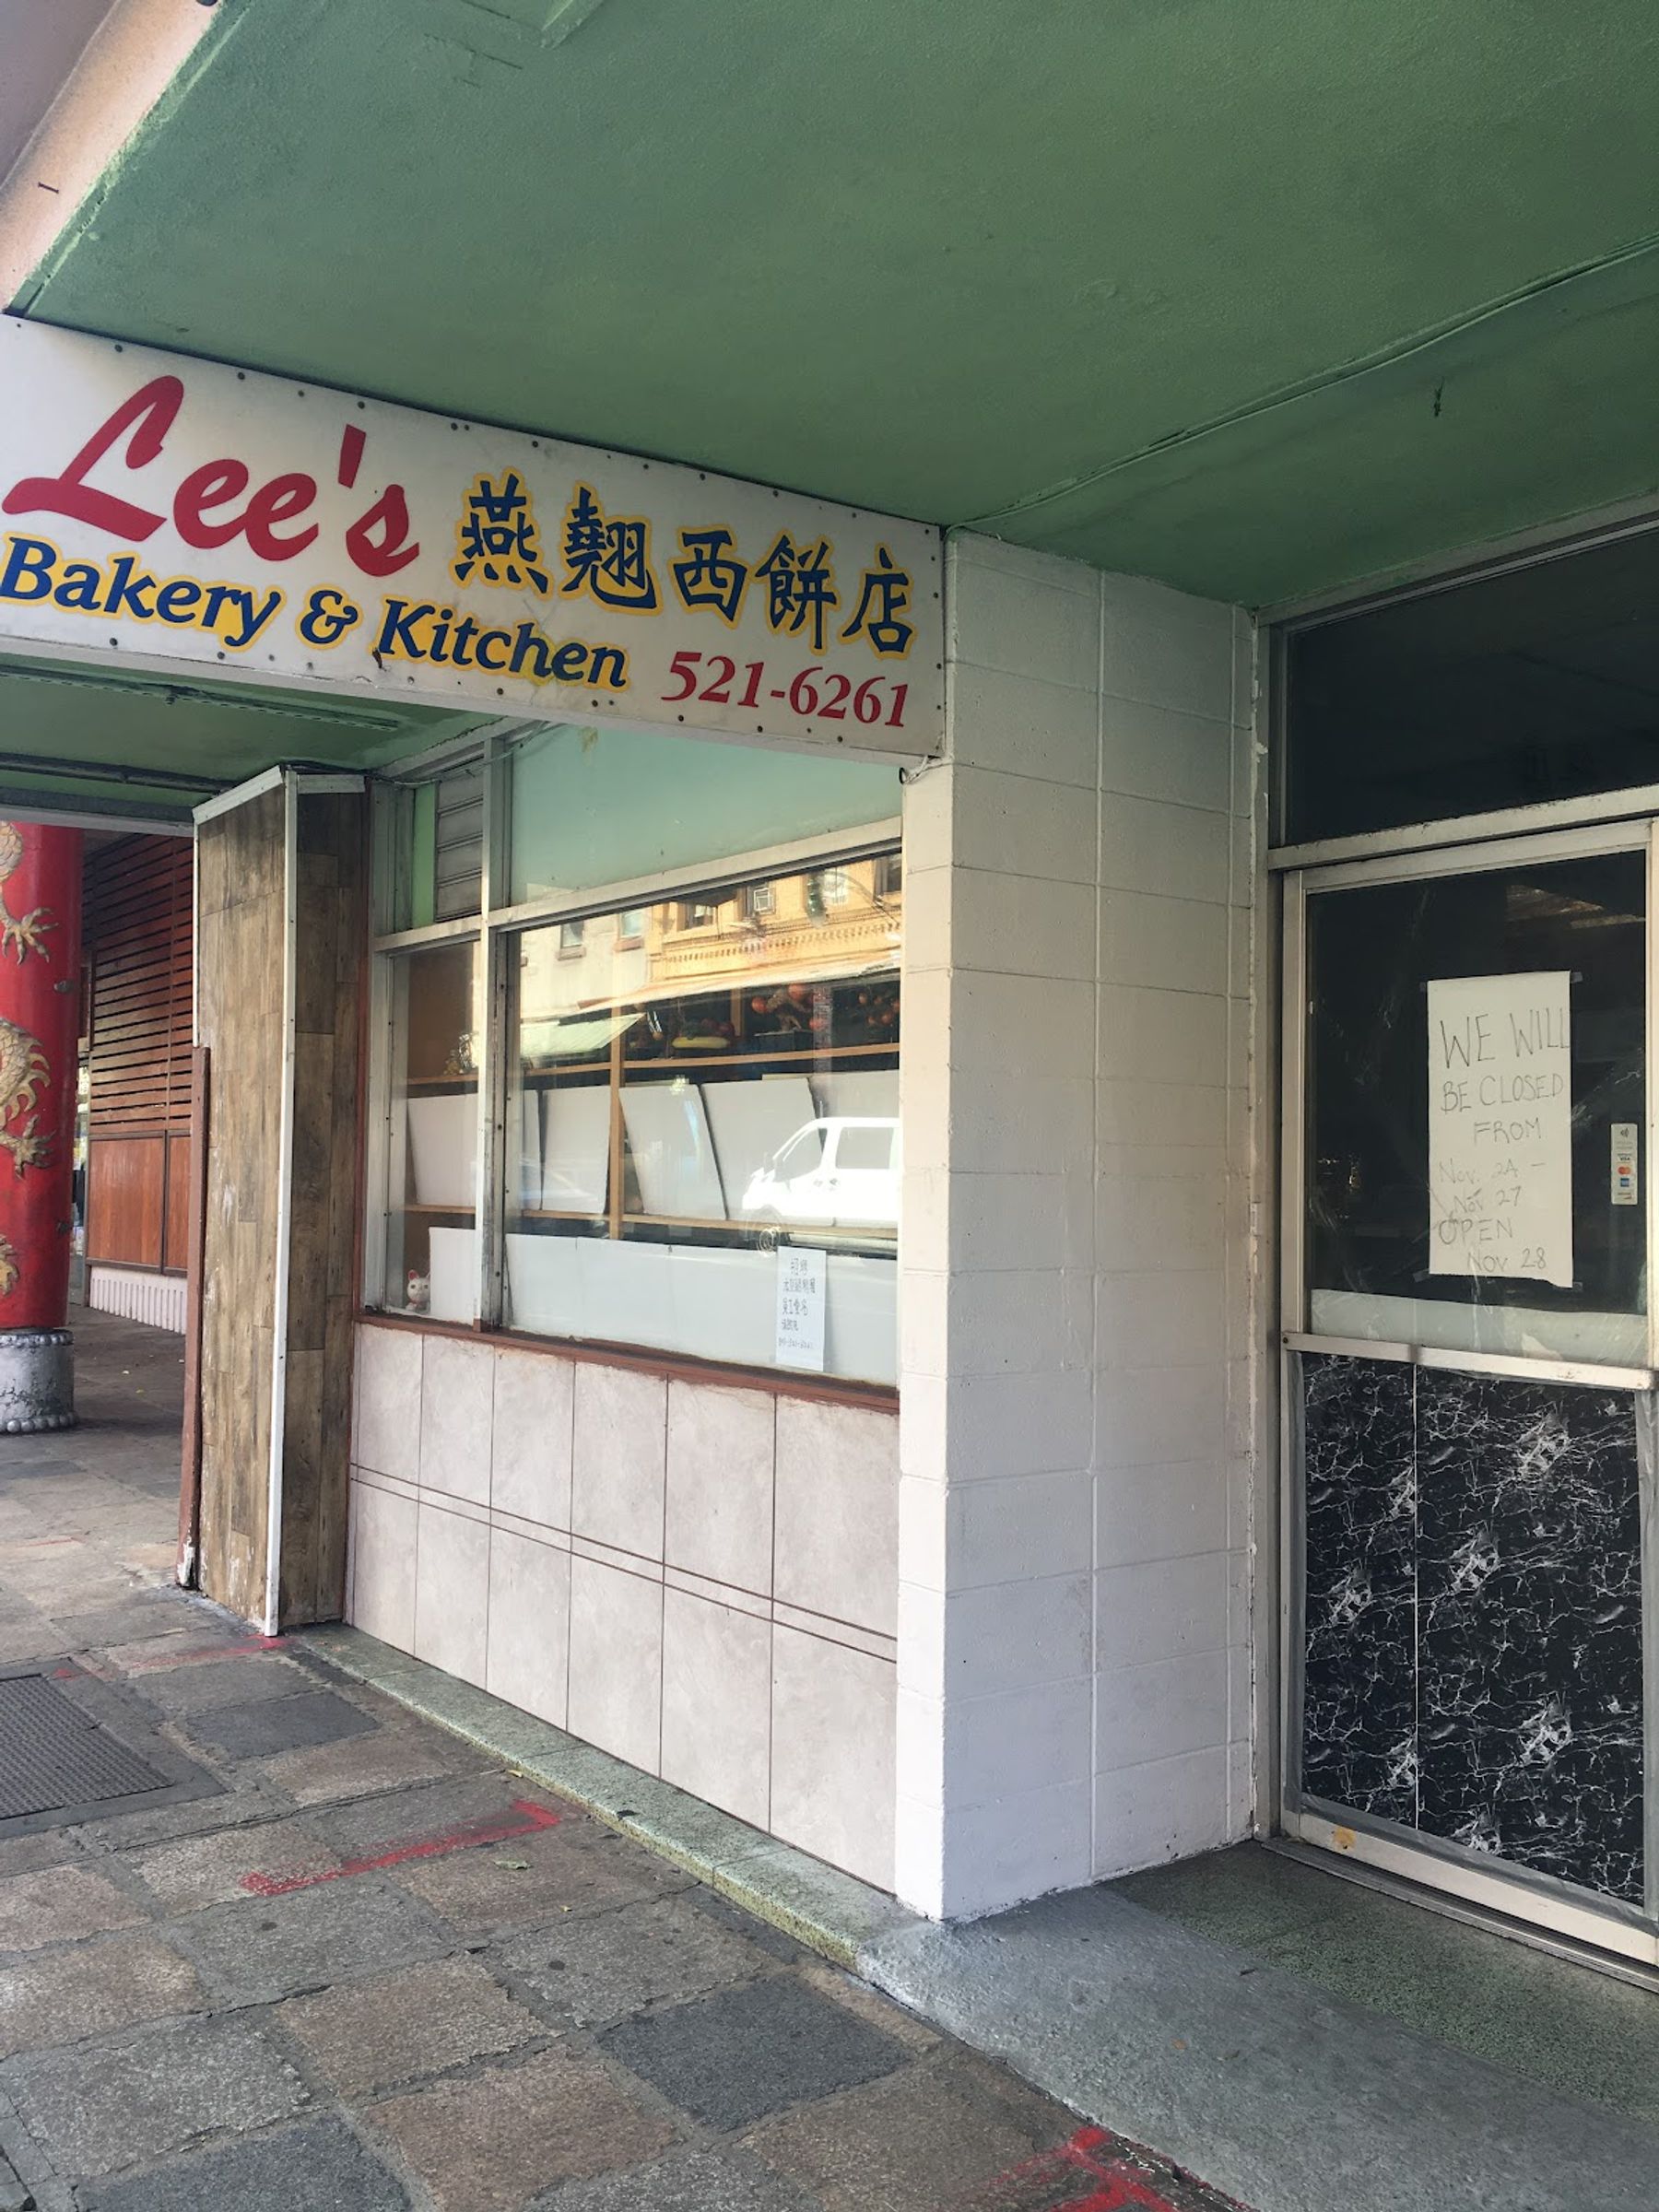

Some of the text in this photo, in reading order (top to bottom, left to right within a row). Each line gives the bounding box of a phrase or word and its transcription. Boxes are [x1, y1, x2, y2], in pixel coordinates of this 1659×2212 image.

[2, 375, 419, 577] Lee's
[458, 473, 912, 653] 燕翹西餅店
[0, 536, 628, 688] Bakery & Kitchen
[661, 651, 909, 727] 521-6261
[1440, 1007, 1571, 1069] WE WILL
[1440, 1074, 1564, 1114] BE CLOSED
[1474, 1117, 1542, 1144] FROM
[1496, 1185, 1522, 1207] 27
[1439, 1217, 1512, 1245] OPEN
[1521, 1247, 1547, 1270] 28
